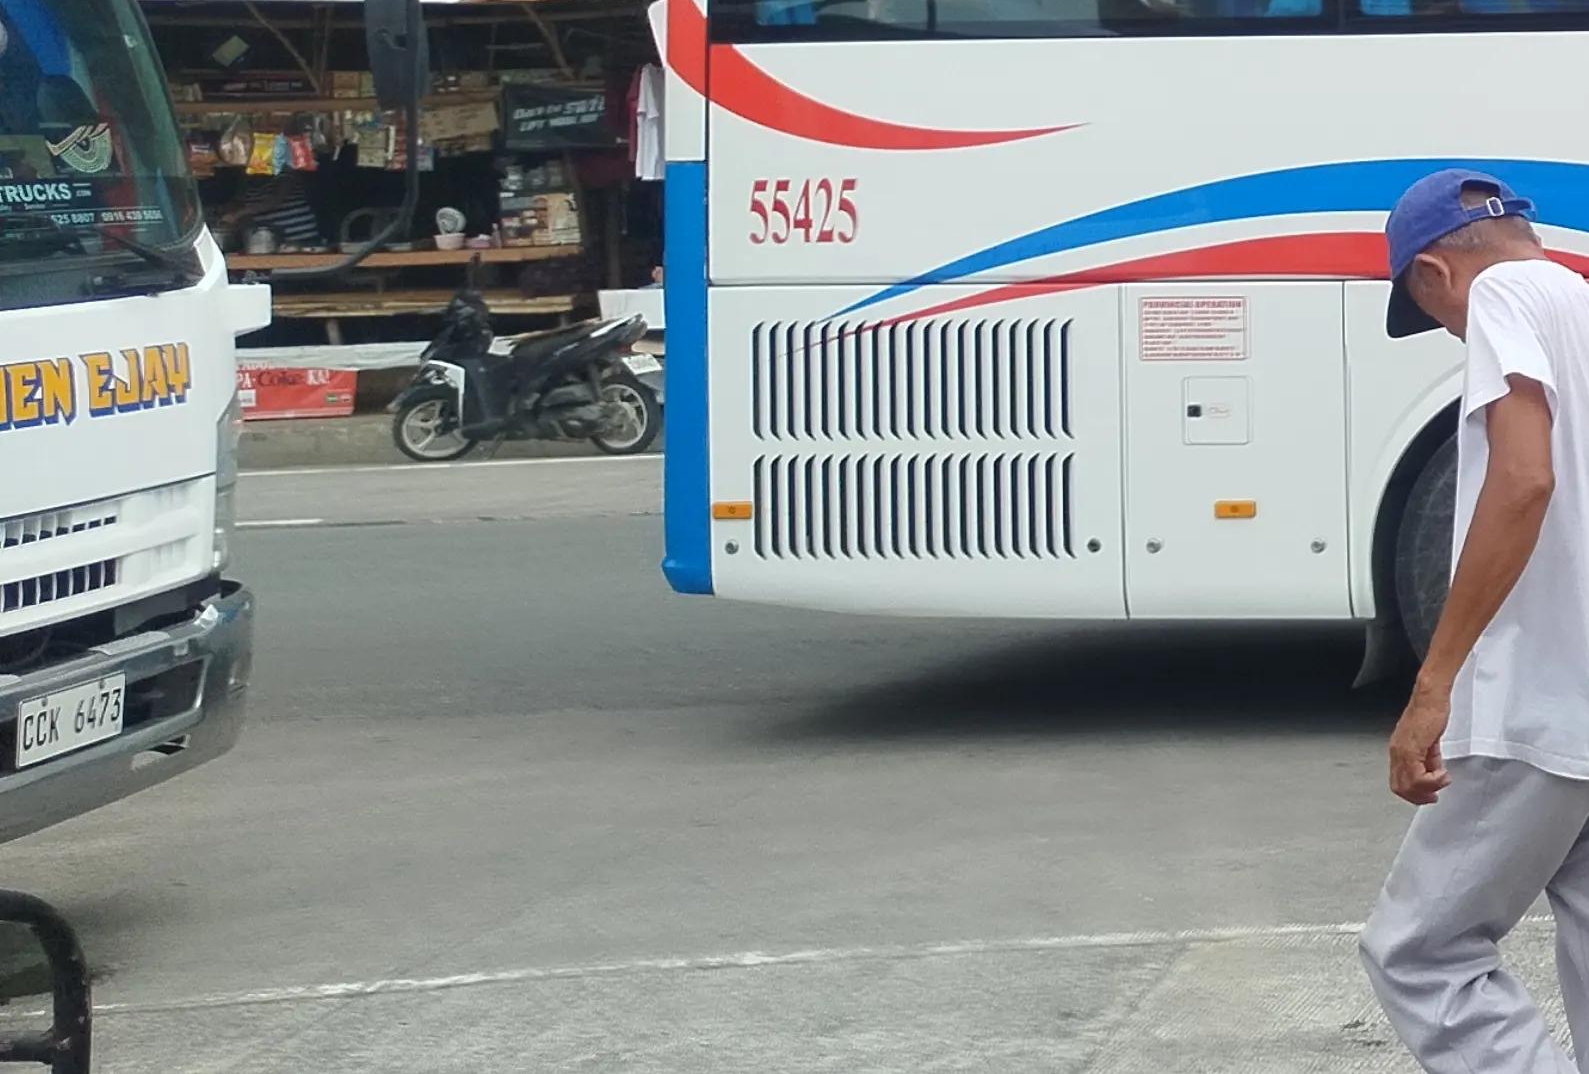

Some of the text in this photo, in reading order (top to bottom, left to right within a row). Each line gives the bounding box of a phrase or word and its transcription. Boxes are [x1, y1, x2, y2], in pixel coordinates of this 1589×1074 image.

[749, 177, 857, 244] 55425
[78, 341, 192, 418] EJAY
[23, 687, 122, 751] CCK 6473
